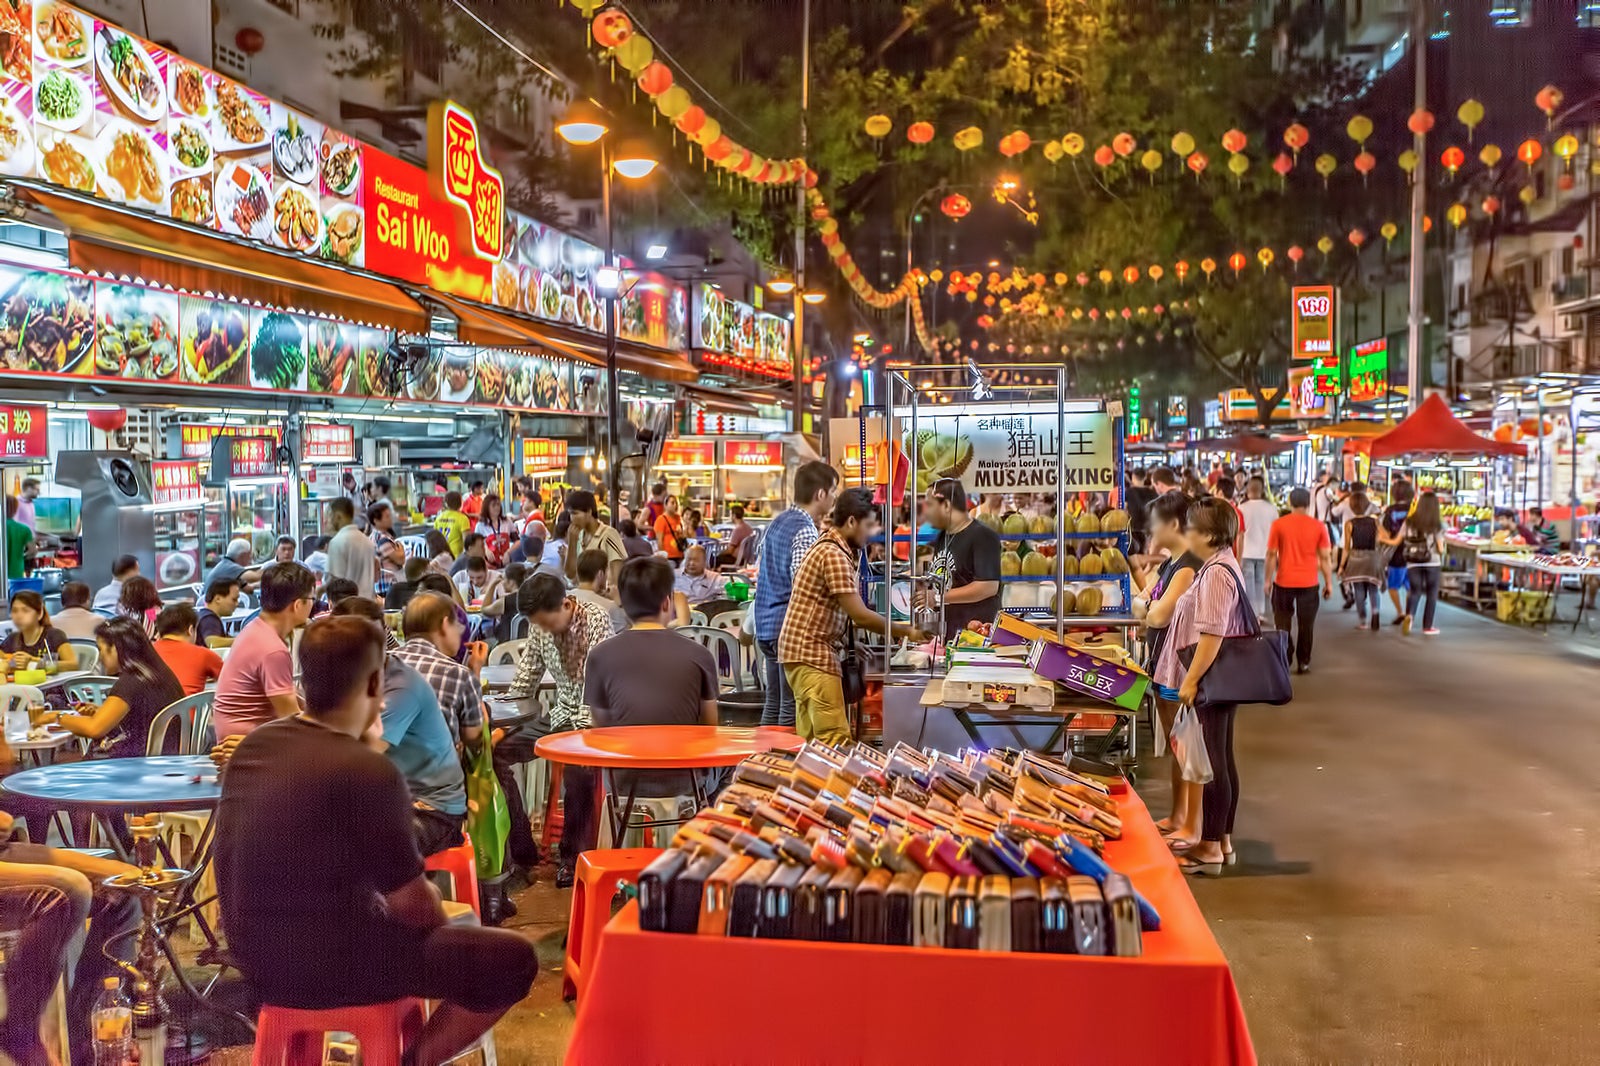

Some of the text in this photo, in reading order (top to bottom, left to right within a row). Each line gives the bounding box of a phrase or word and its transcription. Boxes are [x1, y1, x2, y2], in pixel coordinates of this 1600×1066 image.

[375, 176, 419, 210] Restaurant
[377, 202, 449, 262] Sai Woo
[1299, 297, 1329, 316] 168
[6, 439, 26, 454] MEE
[734, 454, 772, 465] SATAY
[978, 458, 1058, 469] Malaysia Local Frui
[974, 468, 1058, 488] MUSANG
[1067, 667, 1113, 693] SAPEX
